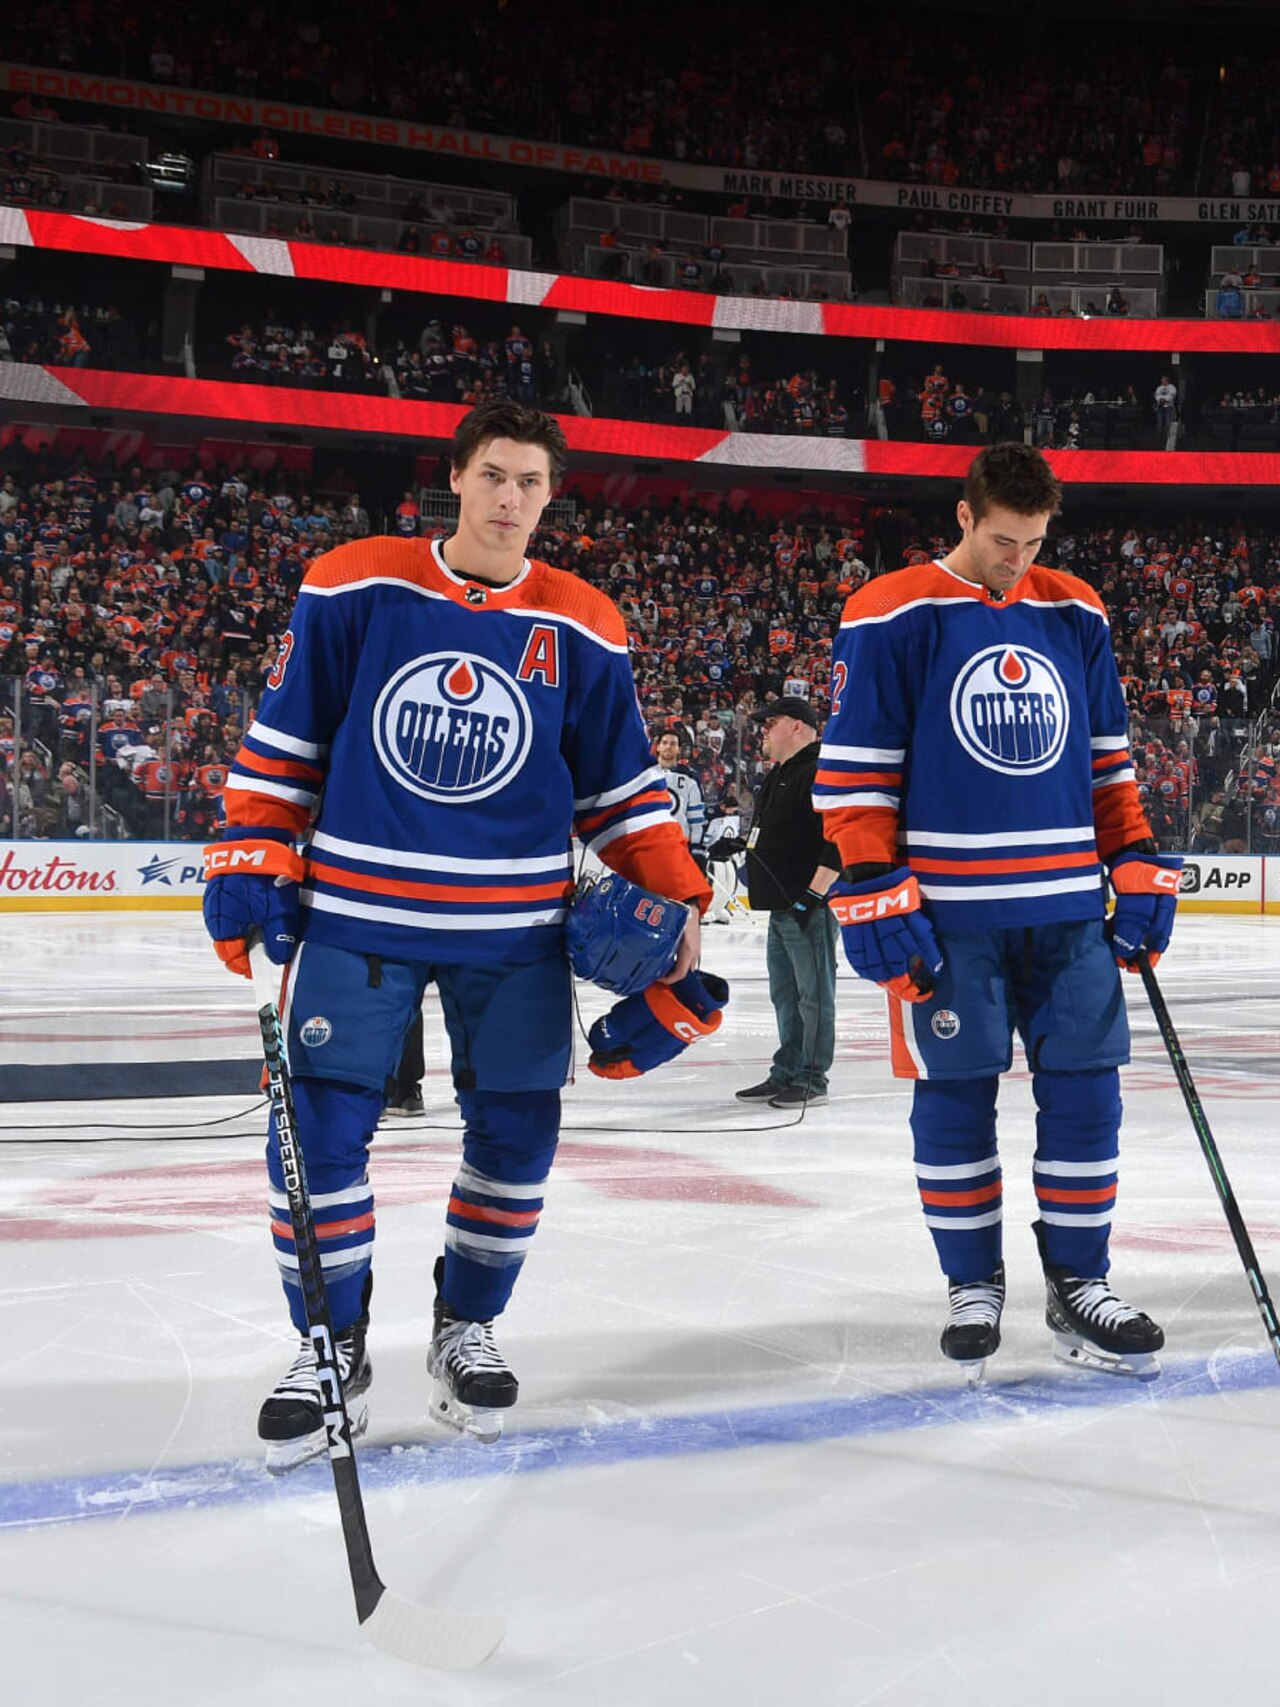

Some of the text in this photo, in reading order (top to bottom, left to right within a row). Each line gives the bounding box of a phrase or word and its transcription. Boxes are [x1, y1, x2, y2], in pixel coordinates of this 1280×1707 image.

[8, 69, 662, 182] EDMONTON OILERS HALL OF FAME
[723, 173, 857, 201] MARK MESSIER
[898, 188, 1014, 215] PAUL COFFEY
[1053, 200, 1159, 219] GRANT FUHR
[1198, 203, 1241, 220] GLEN
[267, 630, 294, 691] 3
[515, 624, 559, 688] A
[831, 661, 849, 715] 2
[396, 700, 510, 770] OILERS
[970, 692, 1057, 745] OILERS
[677, 776, 686, 789] C
[633, 898, 666, 927] 93
[832, 889, 910, 922] CCM
[270, 1071, 300, 1191] JETSPEED
[309, 1323, 351, 1459] CCM
